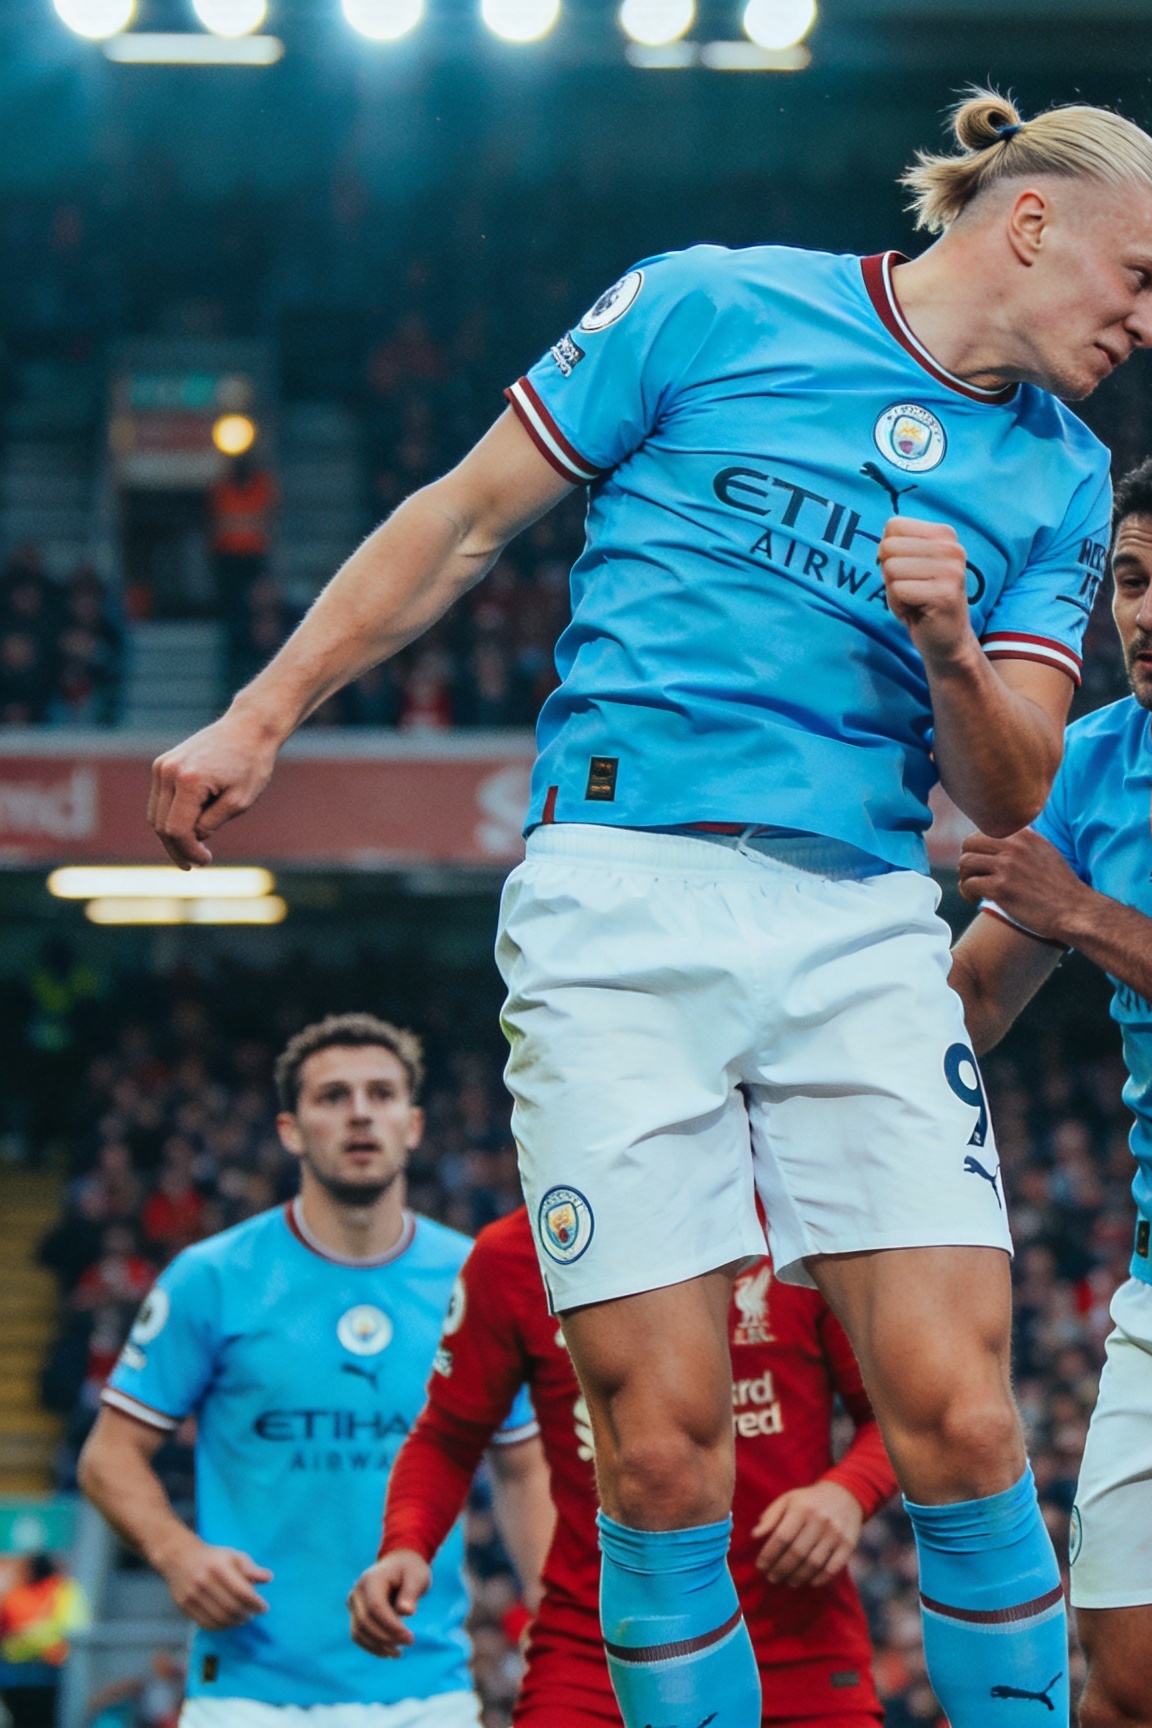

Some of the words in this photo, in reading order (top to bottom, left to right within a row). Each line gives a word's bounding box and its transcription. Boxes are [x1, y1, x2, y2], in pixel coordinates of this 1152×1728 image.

[713, 466, 986, 606] ETIH
[750, 528, 890, 612] AIRWA
[944, 1042, 988, 1148] 9
[254, 1409, 411, 1442] ETIHA
[290, 1451, 392, 1473] AIRWA
